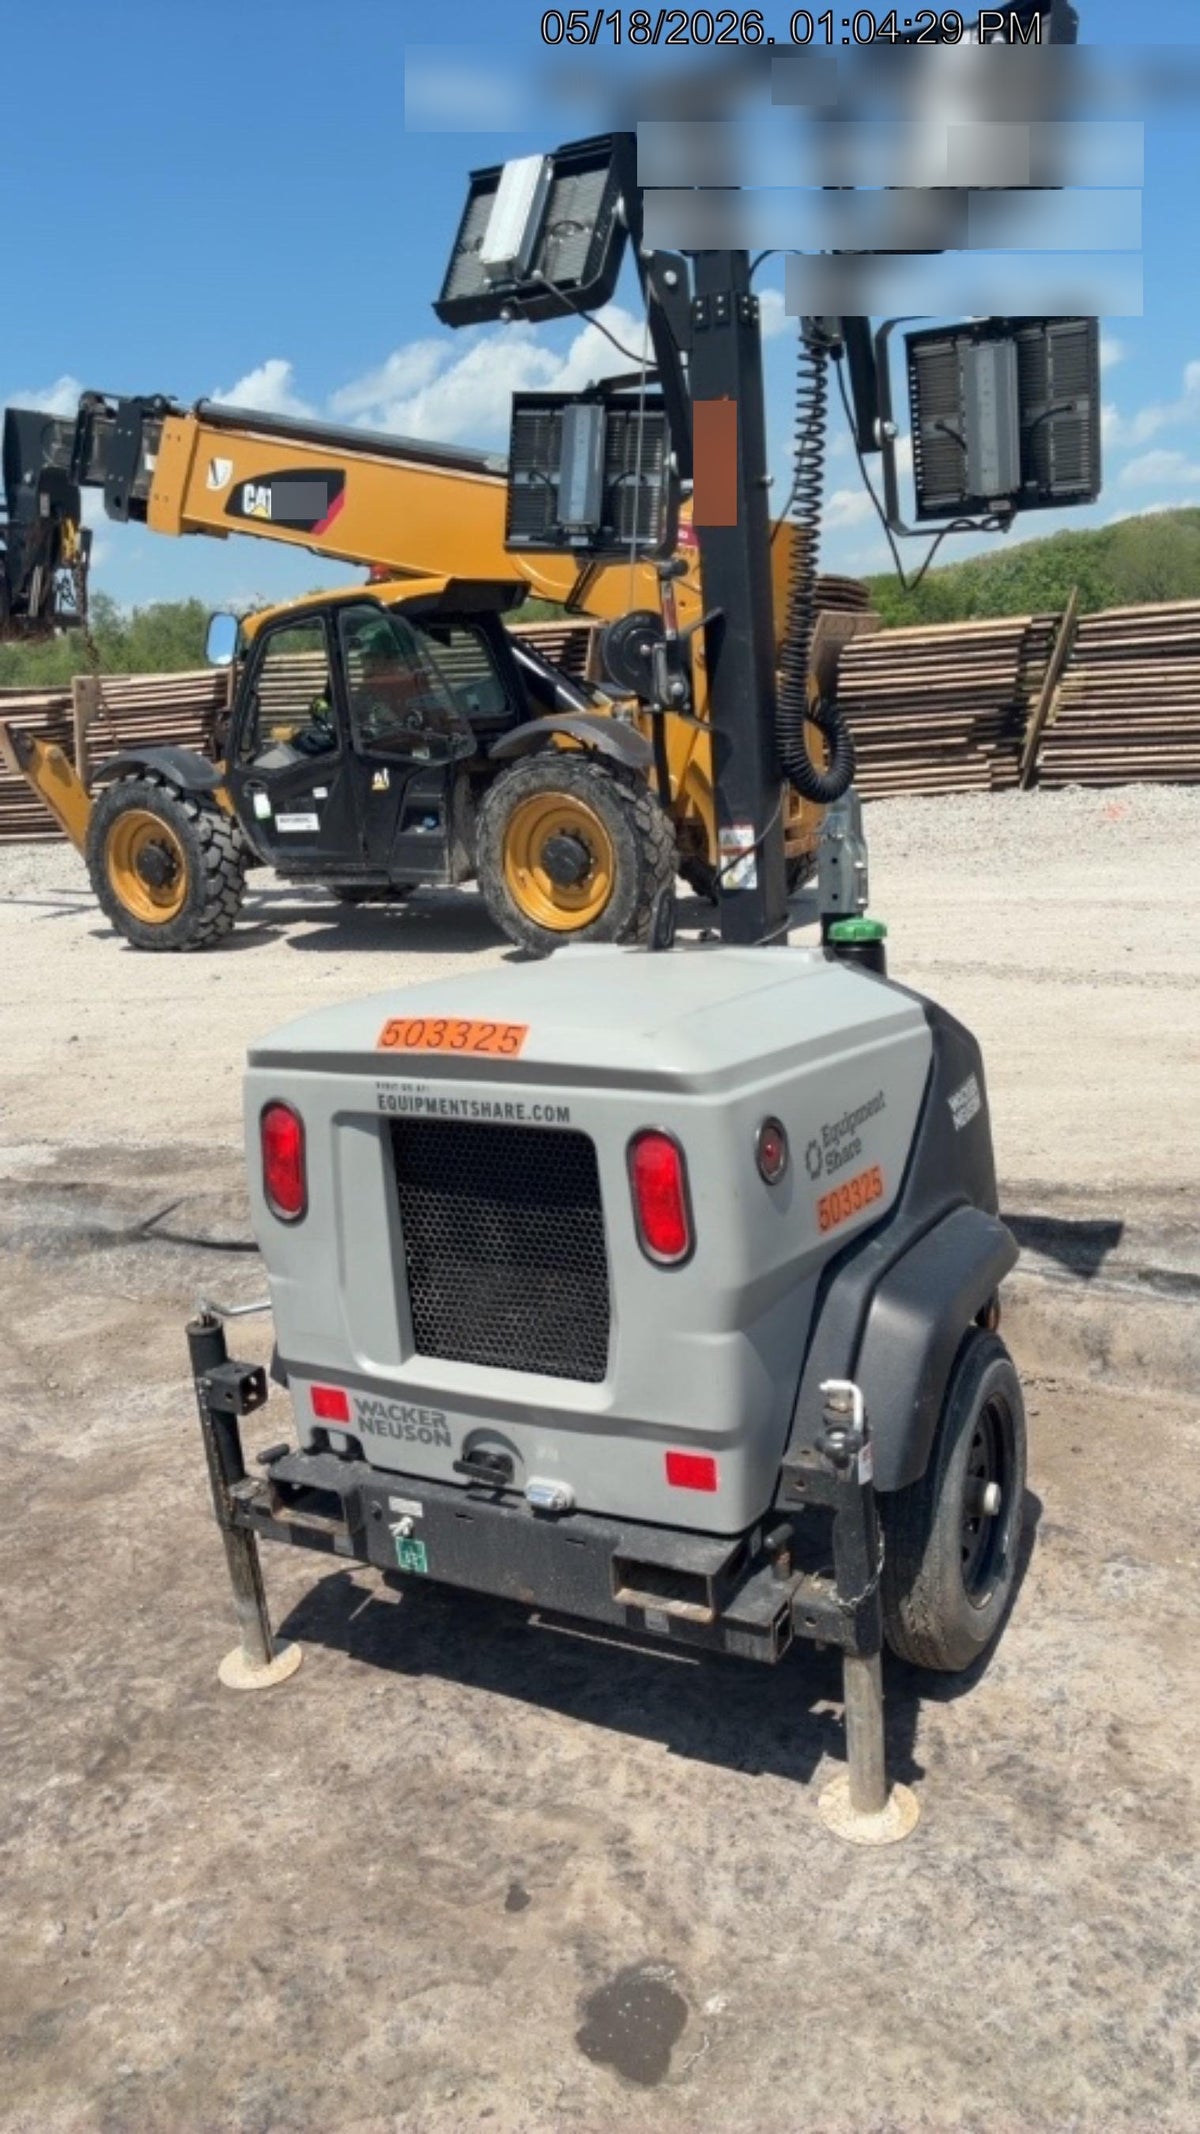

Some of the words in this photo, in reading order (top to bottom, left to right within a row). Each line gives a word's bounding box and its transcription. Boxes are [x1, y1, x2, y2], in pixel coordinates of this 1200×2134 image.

[381, 1019, 526, 1054] 503325
[377, 1094, 571, 1123] EQUIPMENTSHARE.COM
[821, 1089, 886, 1147] Equipment
[825, 1137, 862, 1175] Share
[818, 1166, 883, 1232] 503325
[354, 1398, 449, 1430] WACKER
[357, 1416, 452, 1448] NEUSON
